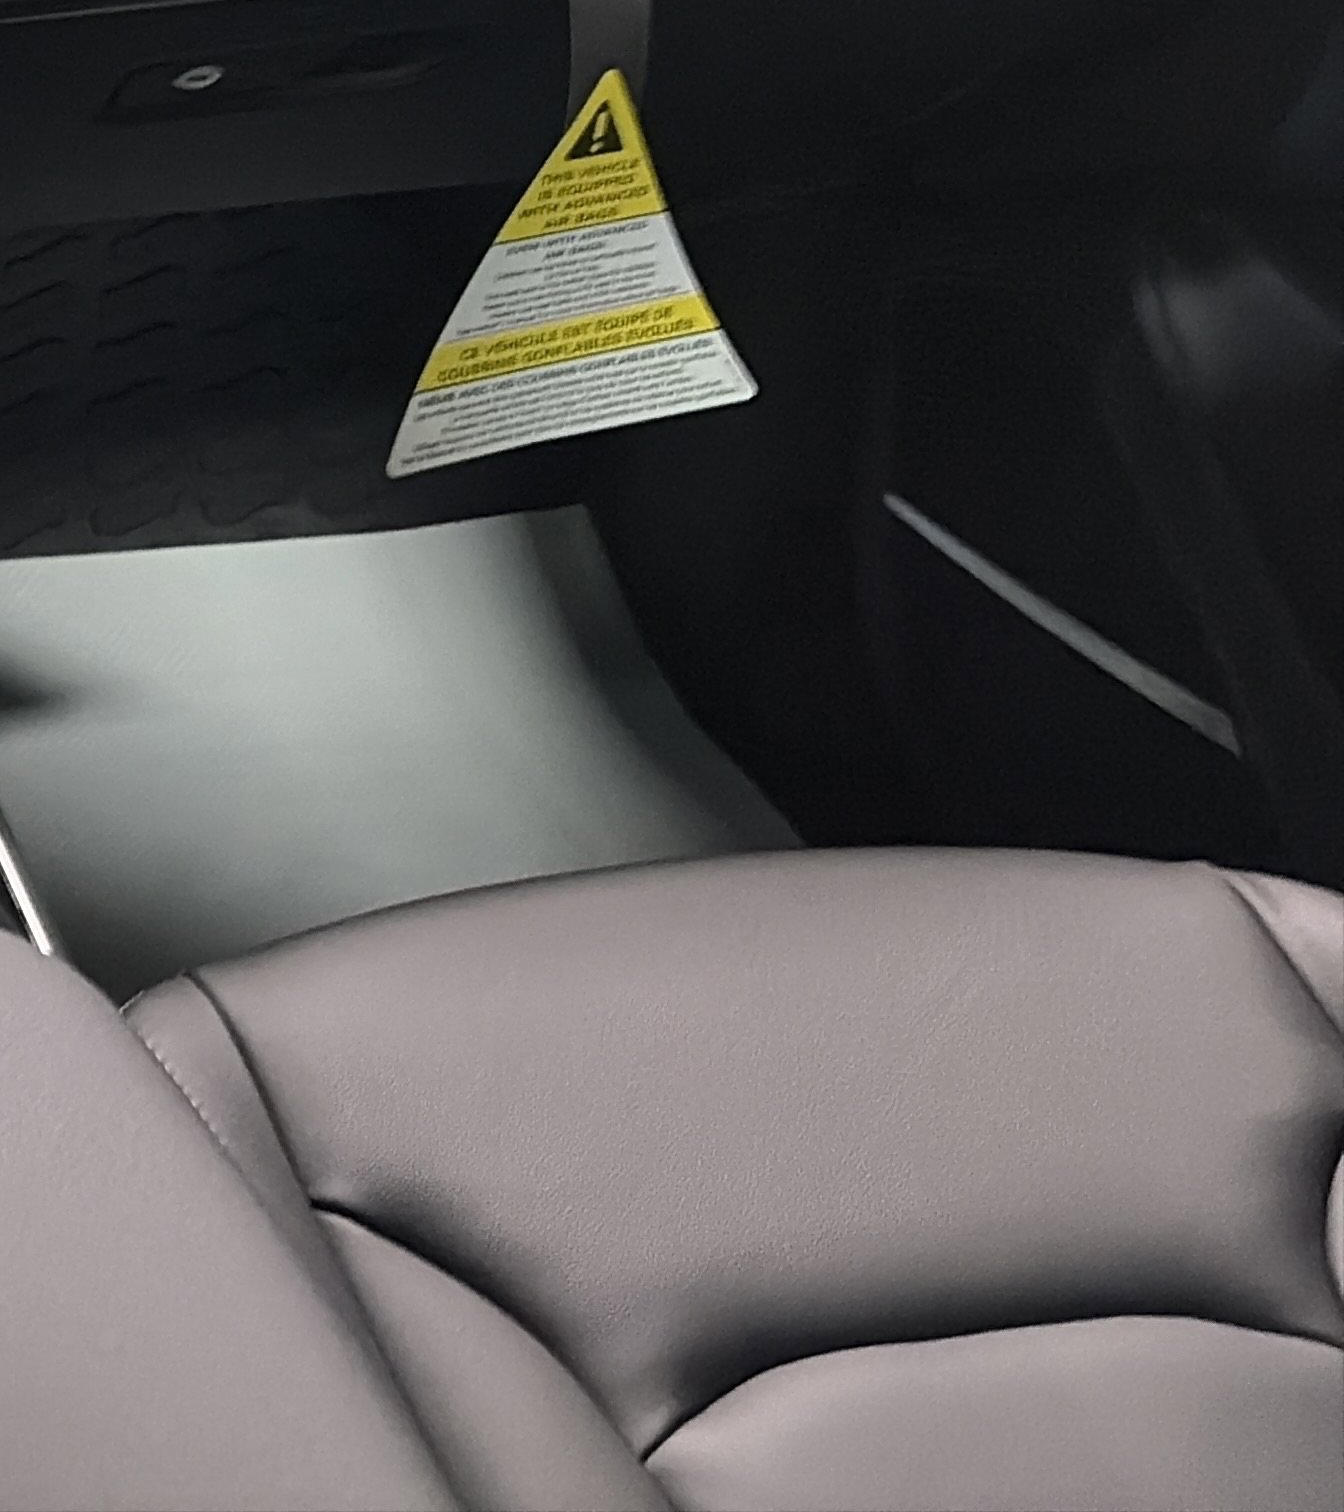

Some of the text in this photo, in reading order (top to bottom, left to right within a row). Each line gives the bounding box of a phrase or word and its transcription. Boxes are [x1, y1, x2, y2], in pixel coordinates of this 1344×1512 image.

[578, 158, 641, 178] VEHICLE
[537, 173, 635, 201] IS EQUIPPED
[518, 185, 650, 220] WITH ADVANCED
